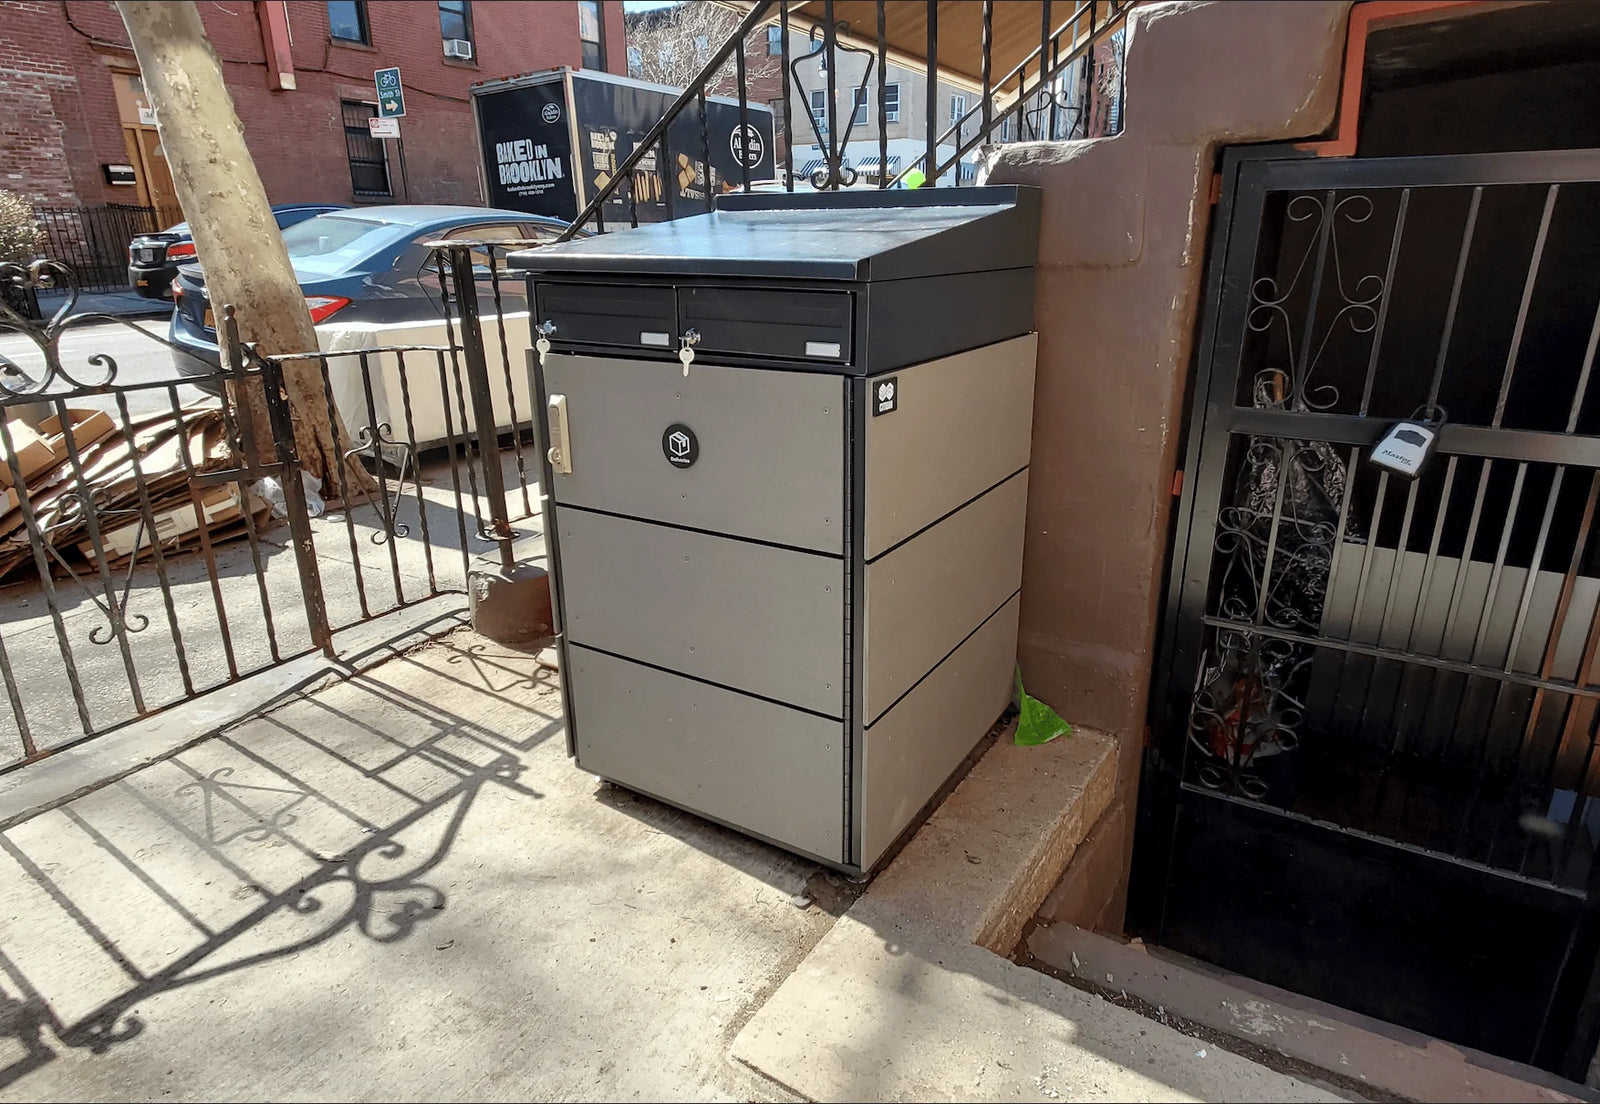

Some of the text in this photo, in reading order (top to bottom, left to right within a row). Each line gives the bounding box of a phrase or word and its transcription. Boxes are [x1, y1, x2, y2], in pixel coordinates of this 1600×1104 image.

[380, 91, 395, 99] Smith
[495, 139, 548, 165] BAKED IN
[733, 137, 761, 152] Aldin
[498, 157, 563, 185] BROOKLYN
[670, 456, 690, 464] Deliveries
[1381, 449, 1412, 466] Master
